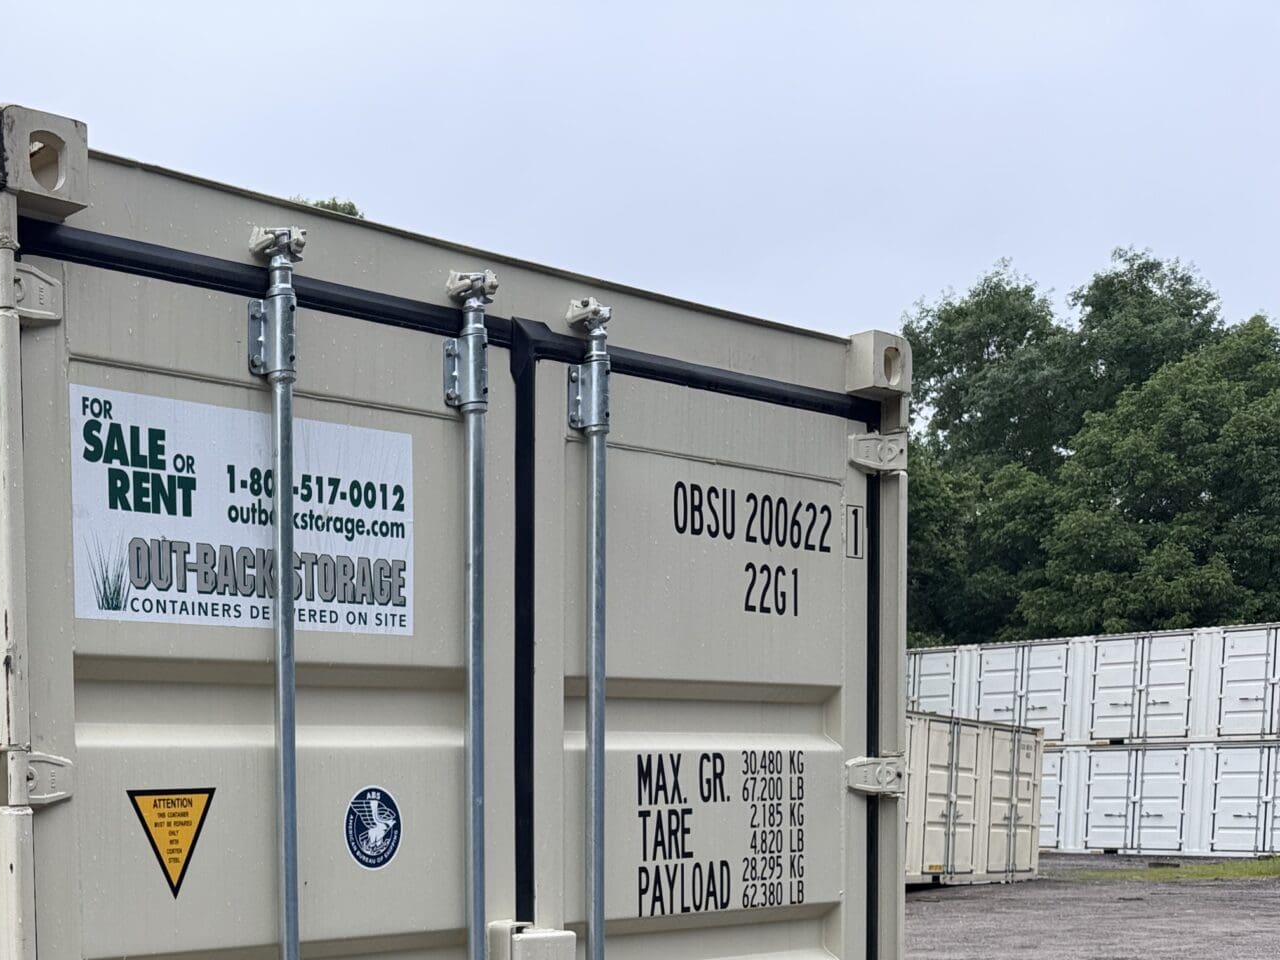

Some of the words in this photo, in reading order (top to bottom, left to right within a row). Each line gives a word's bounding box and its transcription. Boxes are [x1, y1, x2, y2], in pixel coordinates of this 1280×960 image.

[82, 396, 113, 420] FOR
[83, 419, 166, 471] SALE
[173, 453, 195, 474] OR
[108, 467, 196, 517] RENT
[227, 464, 405, 512] 1-80-517-0012
[674, 480, 736, 540] OBSU
[745, 492, 832, 553] 200622
[851, 507, 859, 556] 1
[128, 536, 274, 599] OUT-BACK
[744, 561, 798, 617] 22G1
[130, 597, 242, 620] CONTAINERS
[250, 605, 339, 624] DEERED
[346, 611, 368, 626] ON
[375, 612, 407, 627] SITE
[637, 753, 687, 806] MAX.
[699, 752, 730, 803] GR.
[741, 750, 783, 775] 30,480
[789, 750, 804, 775] KG
[742, 777, 783, 802] 67,200
[789, 776, 804, 801] LB
[153, 798, 193, 809] ATTENTION
[638, 808, 694, 862] TARE
[750, 803, 783, 828] 2,185
[789, 802, 804, 827] KG
[750, 829, 783, 855] 4,820
[789, 828, 804, 853] LB
[638, 860, 731, 918] PAYLOAD
[742, 855, 783, 882] 28,295
[789, 854, 804, 879] KG
[742, 882, 783, 909] 62,380
[789, 880, 804, 905] LB
